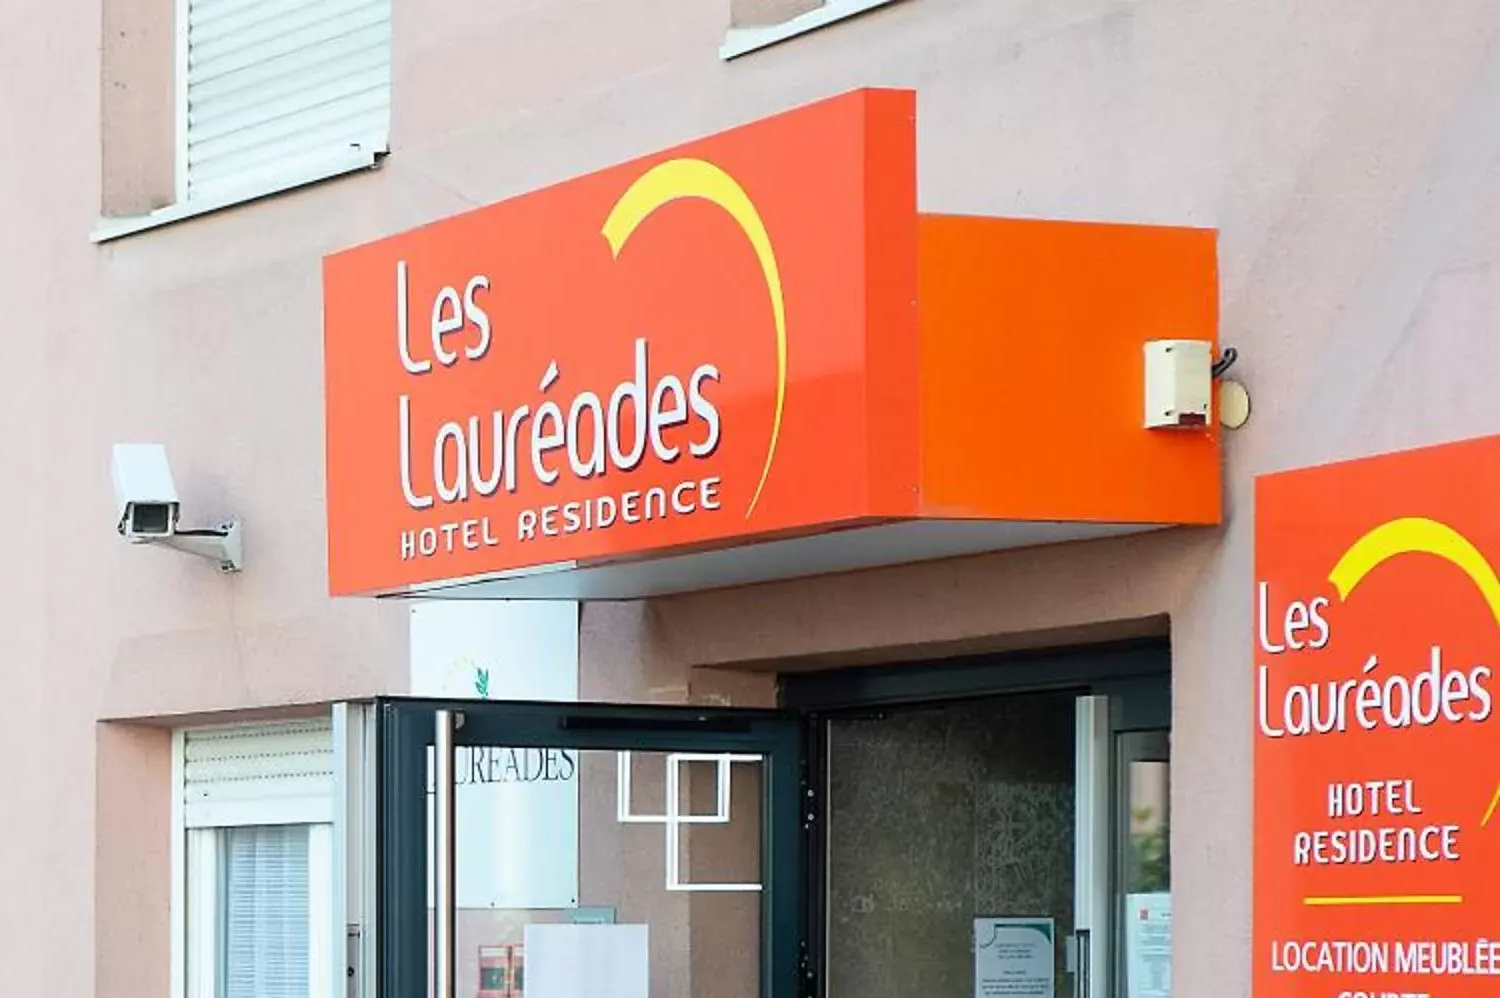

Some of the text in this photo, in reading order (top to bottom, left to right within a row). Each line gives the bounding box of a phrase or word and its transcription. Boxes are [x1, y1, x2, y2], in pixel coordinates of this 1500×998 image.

[396, 259, 491, 373] Les
[399, 337, 721, 508] Lauréades
[401, 477, 721, 559] HOTEL RESIDENCE
[1258, 581, 1329, 653] Les
[1258, 645, 1491, 737] Lauréades
[1327, 779, 1421, 817] HOTEL
[1293, 825, 1459, 865] RESIDENCE
[1271, 941, 1389, 973] LOCATION
